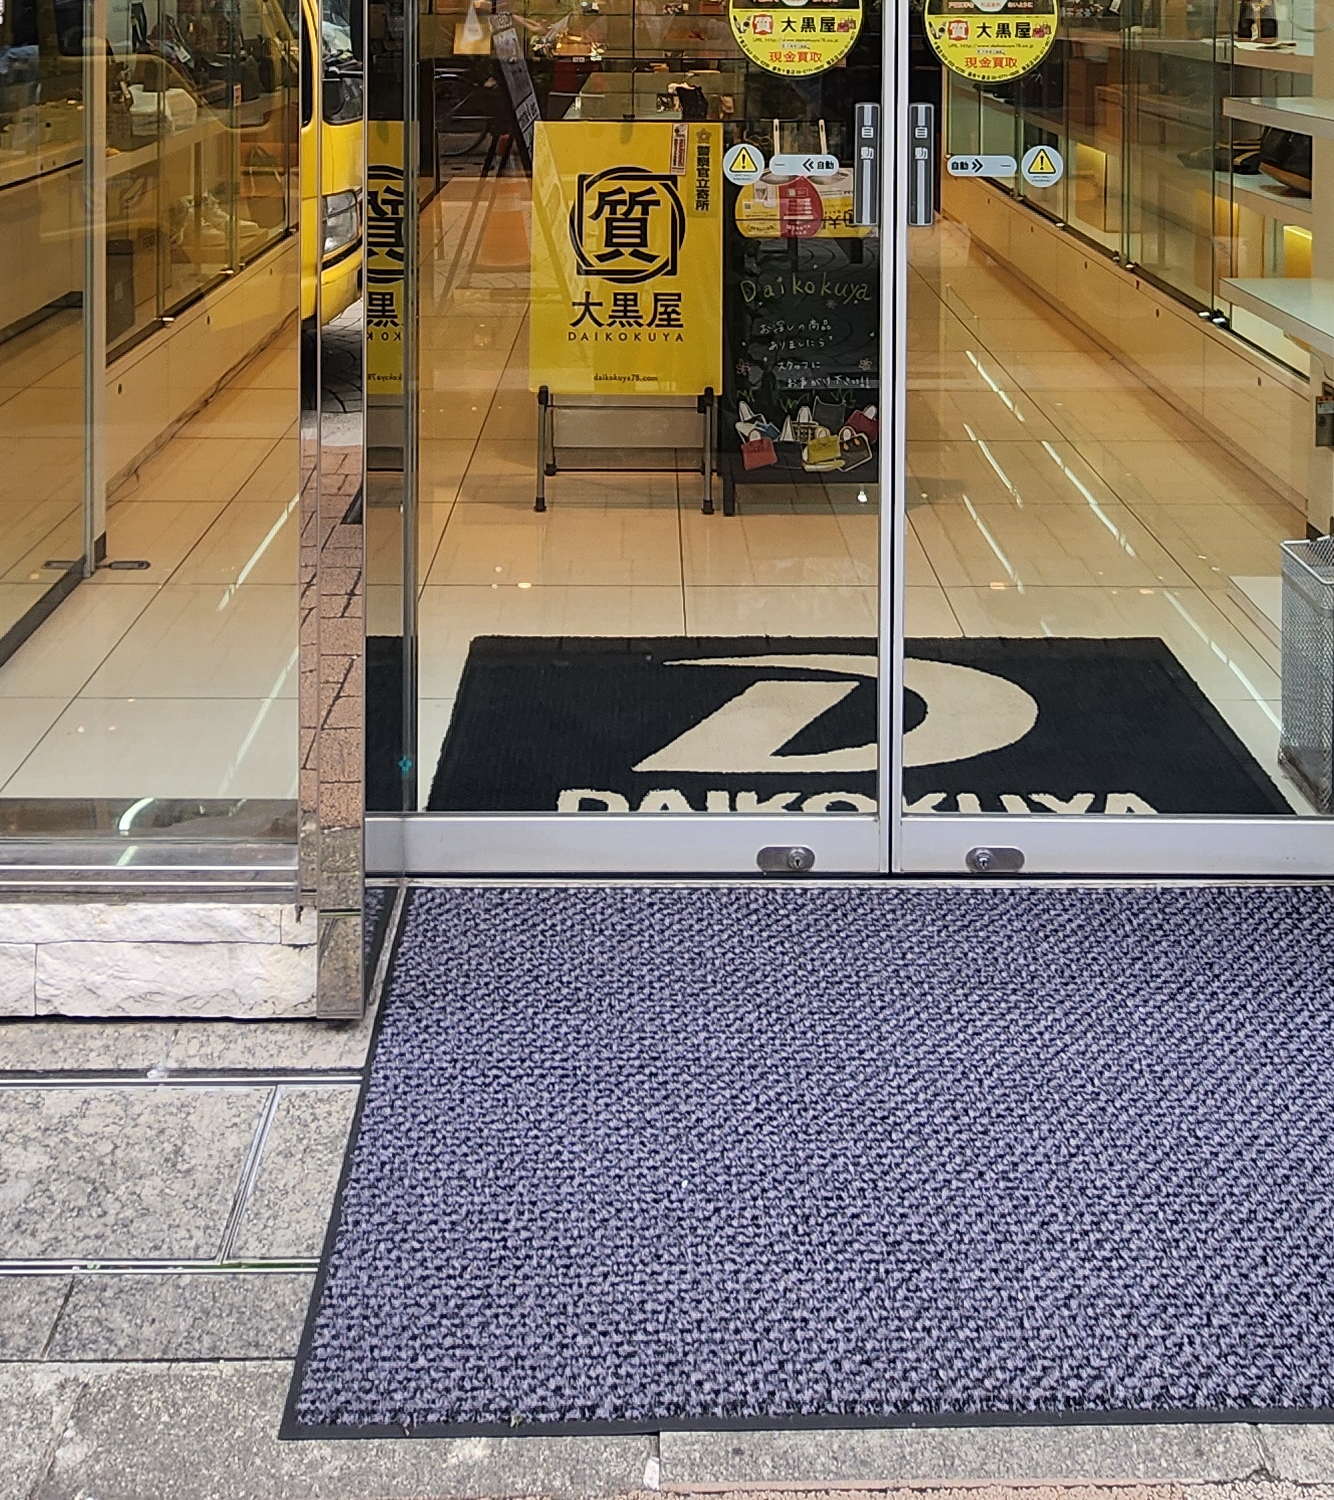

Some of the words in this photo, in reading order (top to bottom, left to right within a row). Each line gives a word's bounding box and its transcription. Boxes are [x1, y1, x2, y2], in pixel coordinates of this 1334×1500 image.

[781, 16, 836, 33] 大黒屋
[976, 21, 1032, 39] 大黒屋
[769, 51, 822, 63] 現金買取
[964, 56, 1018, 69] 現金買取
[860, 126, 874, 160] 自動
[914, 126, 928, 160] 自動
[816, 160, 835, 170] 自動
[951, 161, 969, 171] 自動
[587, 185, 661, 264] 質
[740, 271, 873, 305] Daikokuya
[569, 291, 685, 329] 大黒屋
[568, 331, 685, 342] DAIKOKUYA
